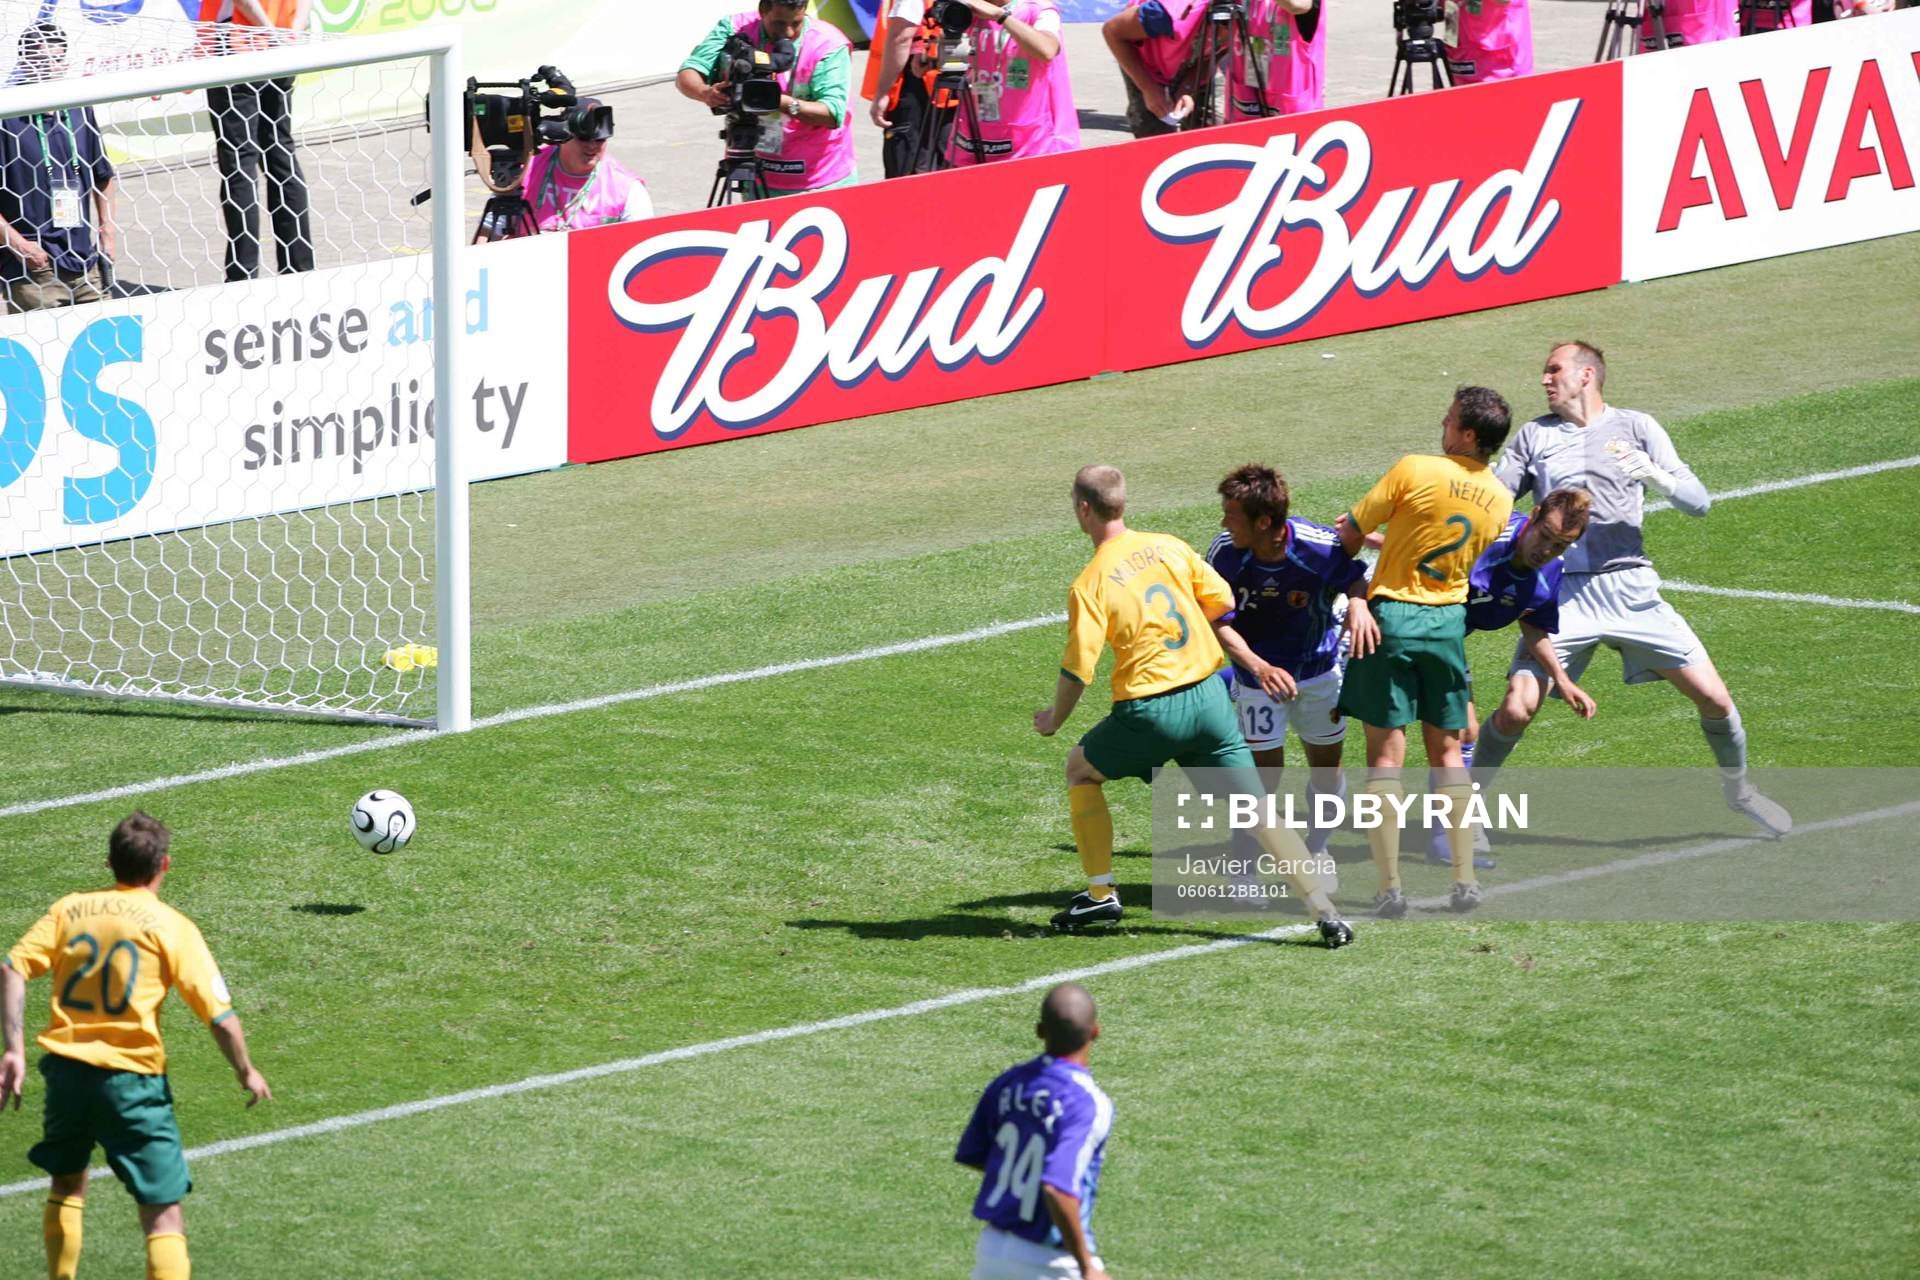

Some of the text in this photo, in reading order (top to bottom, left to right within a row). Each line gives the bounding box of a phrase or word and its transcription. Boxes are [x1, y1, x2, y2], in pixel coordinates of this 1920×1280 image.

[1656, 50, 1920, 234] AVA
[1141, 97, 1584, 349] Bud
[205, 308, 368, 375] sense
[608, 184, 1070, 440] Bud
[1448, 479, 1495, 514] NEILL
[1417, 513, 1472, 582] 2
[1144, 583, 1190, 650] 3
[1247, 705, 1275, 735] 13
[61, 933, 139, 1016] 20
[985, 1121, 1046, 1222] 14
